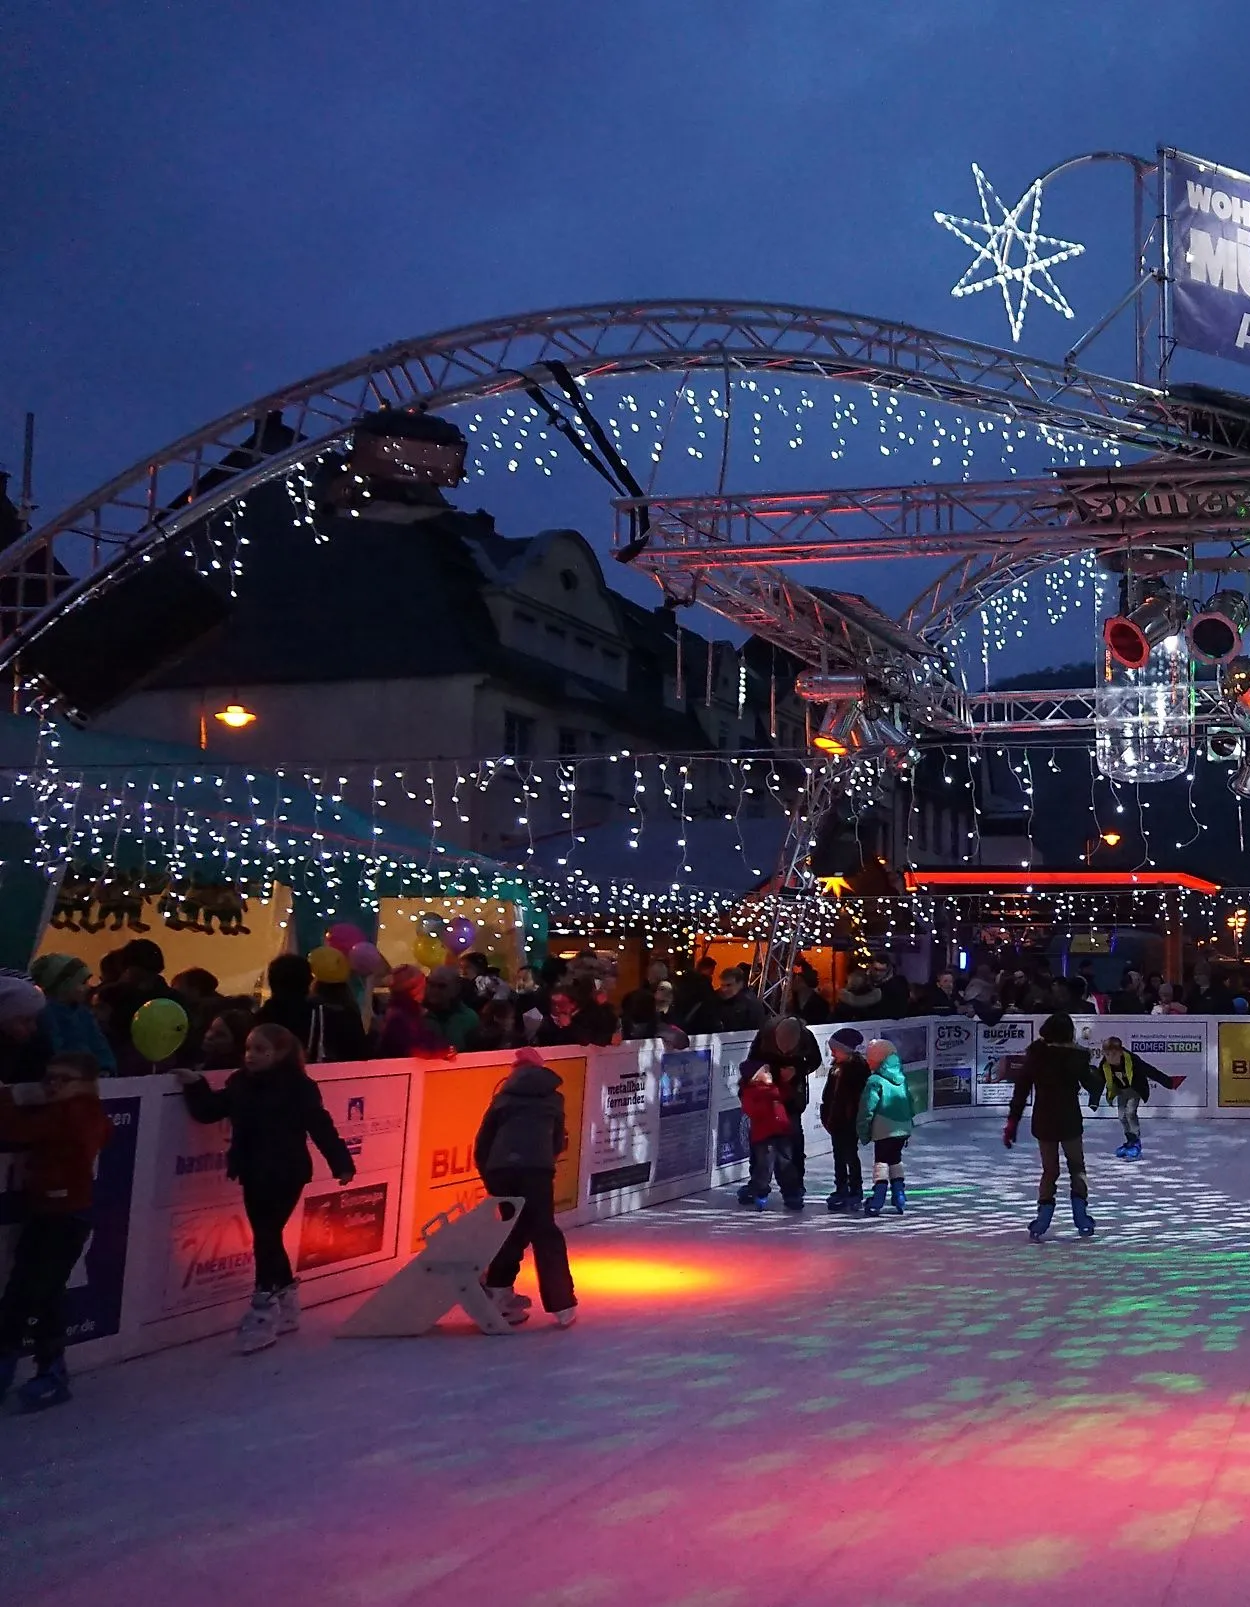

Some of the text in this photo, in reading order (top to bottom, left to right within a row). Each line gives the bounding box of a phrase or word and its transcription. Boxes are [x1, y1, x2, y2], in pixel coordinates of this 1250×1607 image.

[937, 1025, 962, 1039] GTS
[1167, 1042, 1201, 1052] STROM
[607, 1080, 645, 1095] metallbau
[607, 1093, 645, 1108] fernandez
